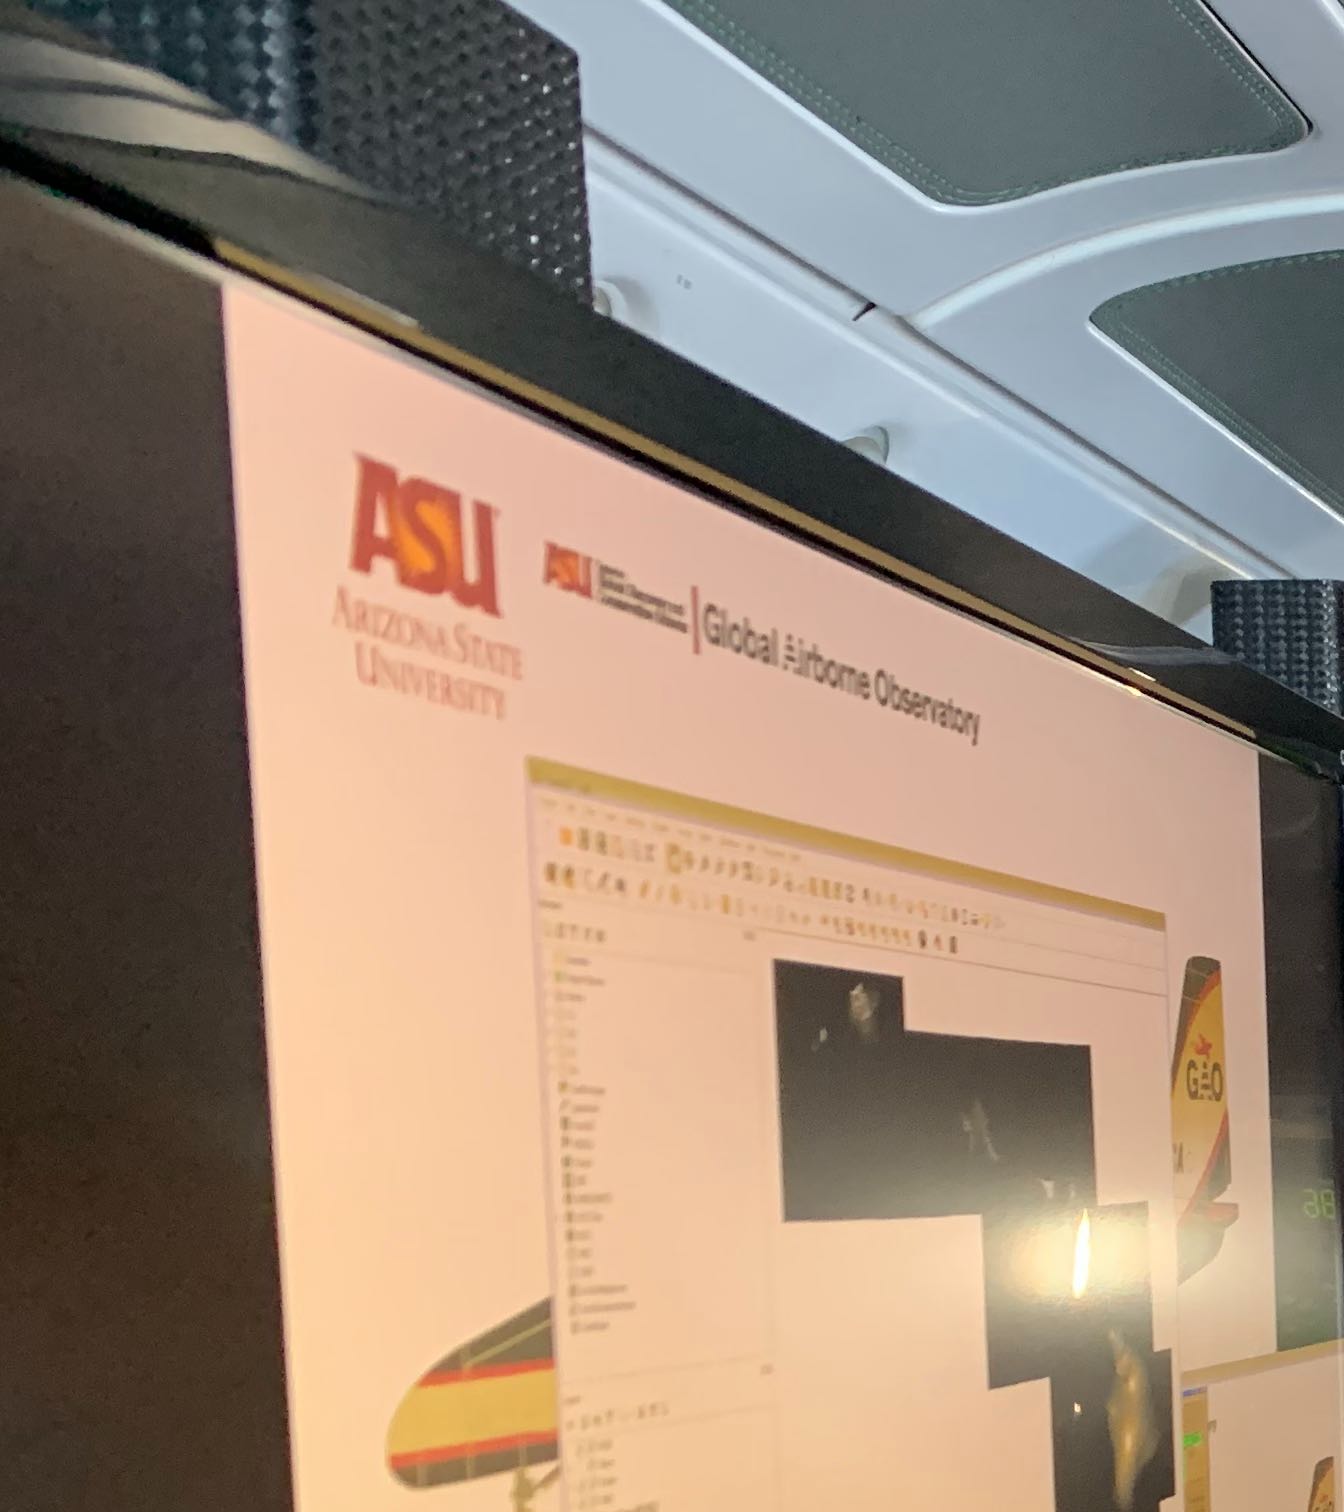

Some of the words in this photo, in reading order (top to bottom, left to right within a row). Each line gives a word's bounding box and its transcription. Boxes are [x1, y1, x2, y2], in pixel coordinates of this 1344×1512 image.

[349, 451, 503, 619] ASU
[332, 584, 448, 655] ARIZONA
[453, 622, 524, 681] STATE
[354, 641, 505, 721] UNIVERSITY
[703, 602, 778, 667] Global
[782, 632, 871, 700] Airborne
[874, 668, 980, 747] Observatory
